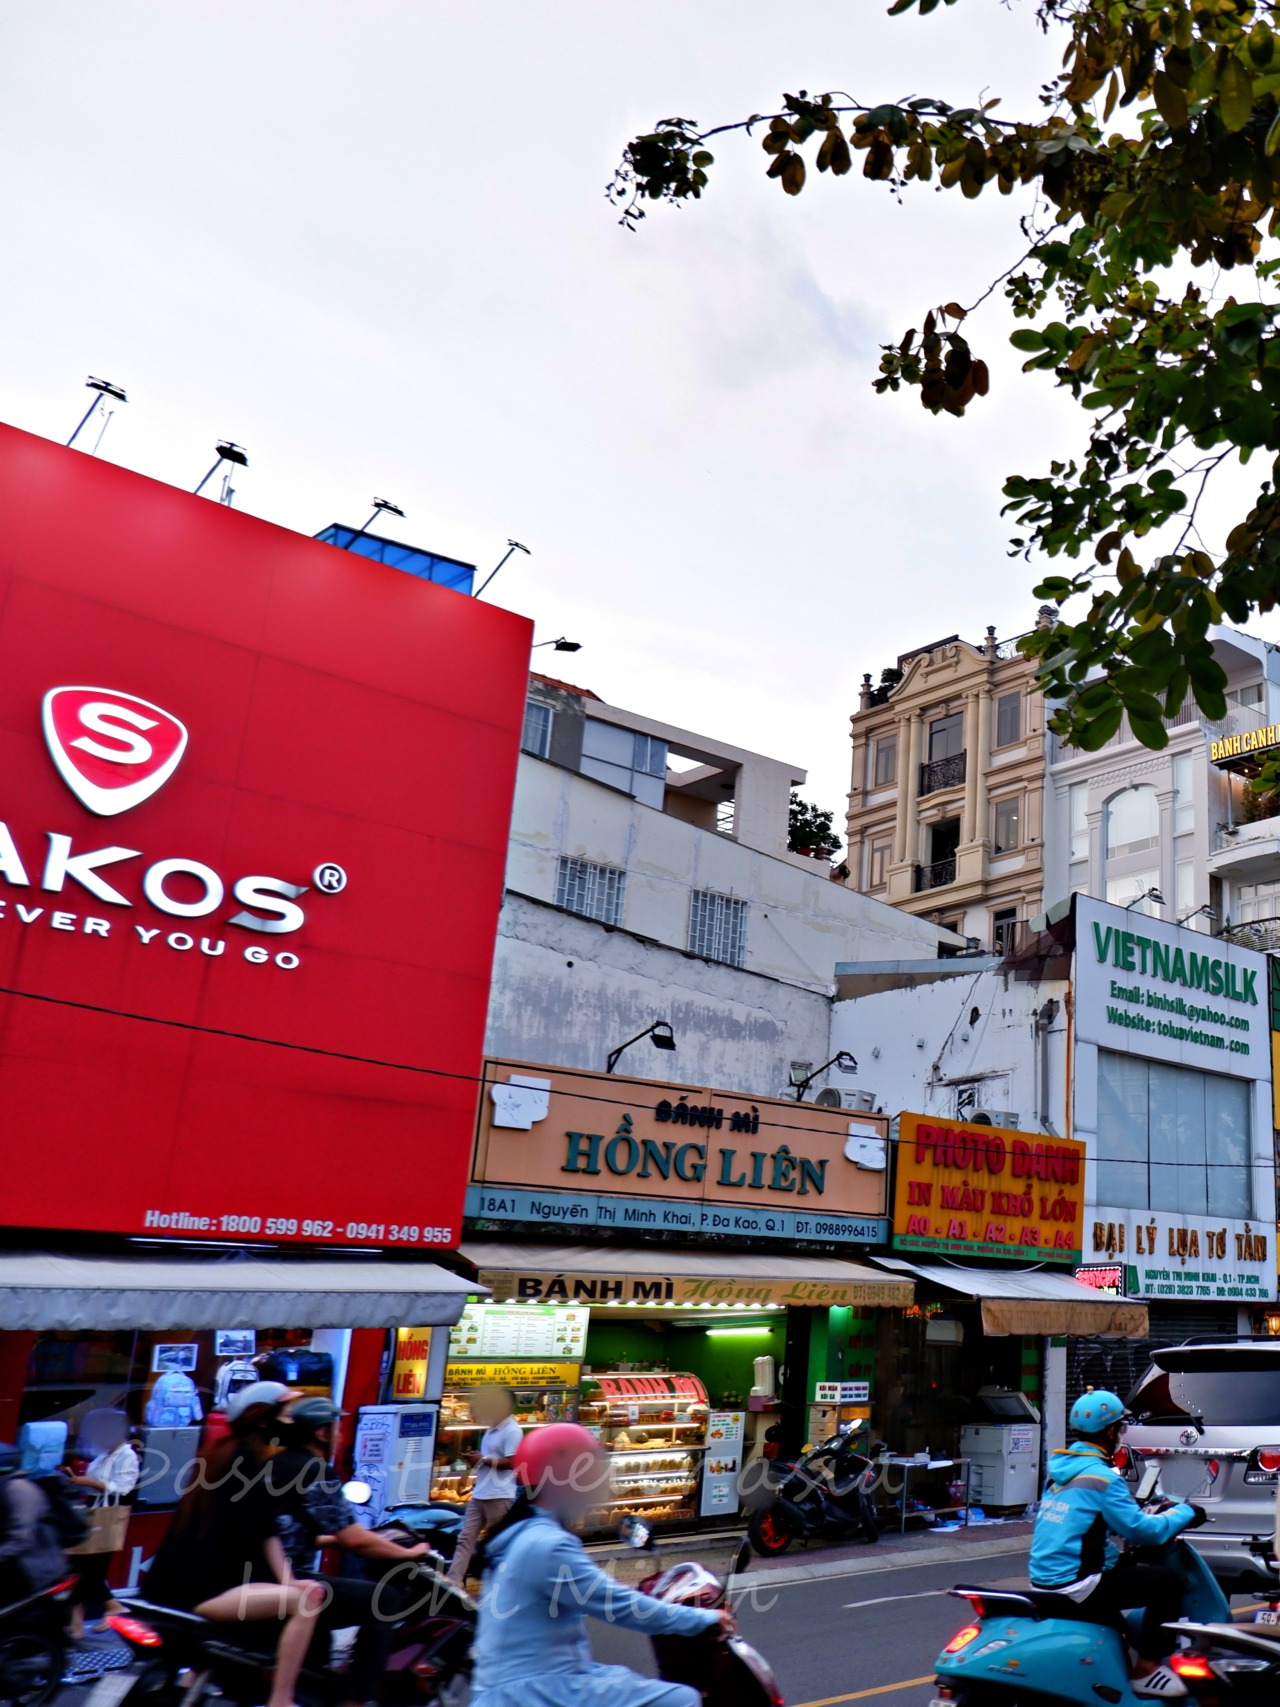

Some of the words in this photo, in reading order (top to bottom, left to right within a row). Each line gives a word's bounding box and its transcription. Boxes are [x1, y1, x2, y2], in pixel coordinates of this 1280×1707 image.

[1210, 734, 1242, 761] BÁNH
[1243, 725, 1277, 751] CANH
[135, 925, 226, 956] YOU
[243, 945, 300, 970] GO
[1091, 921, 1259, 1006] VIETNAMSILK
[1106, 1005, 1156, 1034] Website:
[1110, 980, 1145, 1005] Email:
[1146, 989, 1250, 1032] binhsilk@yahoo.com
[654, 1095, 723, 1129] BÁNH
[729, 1105, 760, 1134] MÌ
[561, 1113, 707, 1182] HỒNG
[717, 1144, 829, 1196] LIÊN
[915, 1124, 1006, 1175] PHOTO
[1011, 1139, 1081, 1186] DANH
[481, 1197, 516, 1213] 18A1
[530, 1200, 589, 1219] Nguyễn
[597, 1206, 616, 1223] Thị
[624, 1208, 656, 1223] Minh
[663, 1210, 696, 1227] Khai,
[734, 1216, 762, 1232] Kao,
[765, 1218, 785, 1233] Q.1
[796, 1221, 813, 1234] ĐT:
[815, 1222, 878, 1238] 0988996415
[907, 1181, 933, 1206] IN
[940, 1180, 987, 1213] MÀU
[990, 1183, 1034, 1218] KHỔ
[1039, 1189, 1078, 1223] LỚN
[145, 1210, 217, 1231] Hotline:
[219, 1215, 261, 1234] 1800
[265, 1218, 298, 1236] 599
[301, 1219, 334, 1238] 962
[346, 1222, 385, 1240] 0941
[388, 1225, 419, 1242] 349
[423, 1227, 452, 1244] 955
[907, 1214, 931, 1236] A0
[947, 1218, 968, 1240] A1
[985, 1222, 1008, 1243] A2
[1020, 1226, 1041, 1246] A3
[1054, 1230, 1075, 1249] A4
[1093, 1222, 1125, 1260] ĐẠI
[1136, 1217, 1158, 1255] LÝ
[1168, 1227, 1200, 1265] LỤA
[1206, 1228, 1227, 1260] TƠ
[517, 1273, 623, 1300] BÁNH
[633, 1276, 674, 1300] MÌ
[683, 1278, 773, 1304] Hồng
[781, 1281, 849, 1301] Liên
[1145, 1267, 1170, 1281] NGUYỄN
[1172, 1270, 1183, 1282] THỊ
[1184, 1270, 1200, 1282] MINH
[1202, 1272, 1217, 1283] KHAI
[1237, 1274, 1260, 1285] TP.HCM
[1177, 1286, 1193, 1296] 3823
[1195, 1287, 1211, 1296] 7765
[1227, 1288, 1243, 1297] 0904
[398, 1333, 429, 1360] HỒNG
[395, 1369, 423, 1394] LIÊN
[530, 1366, 558, 1375] LIÊN
